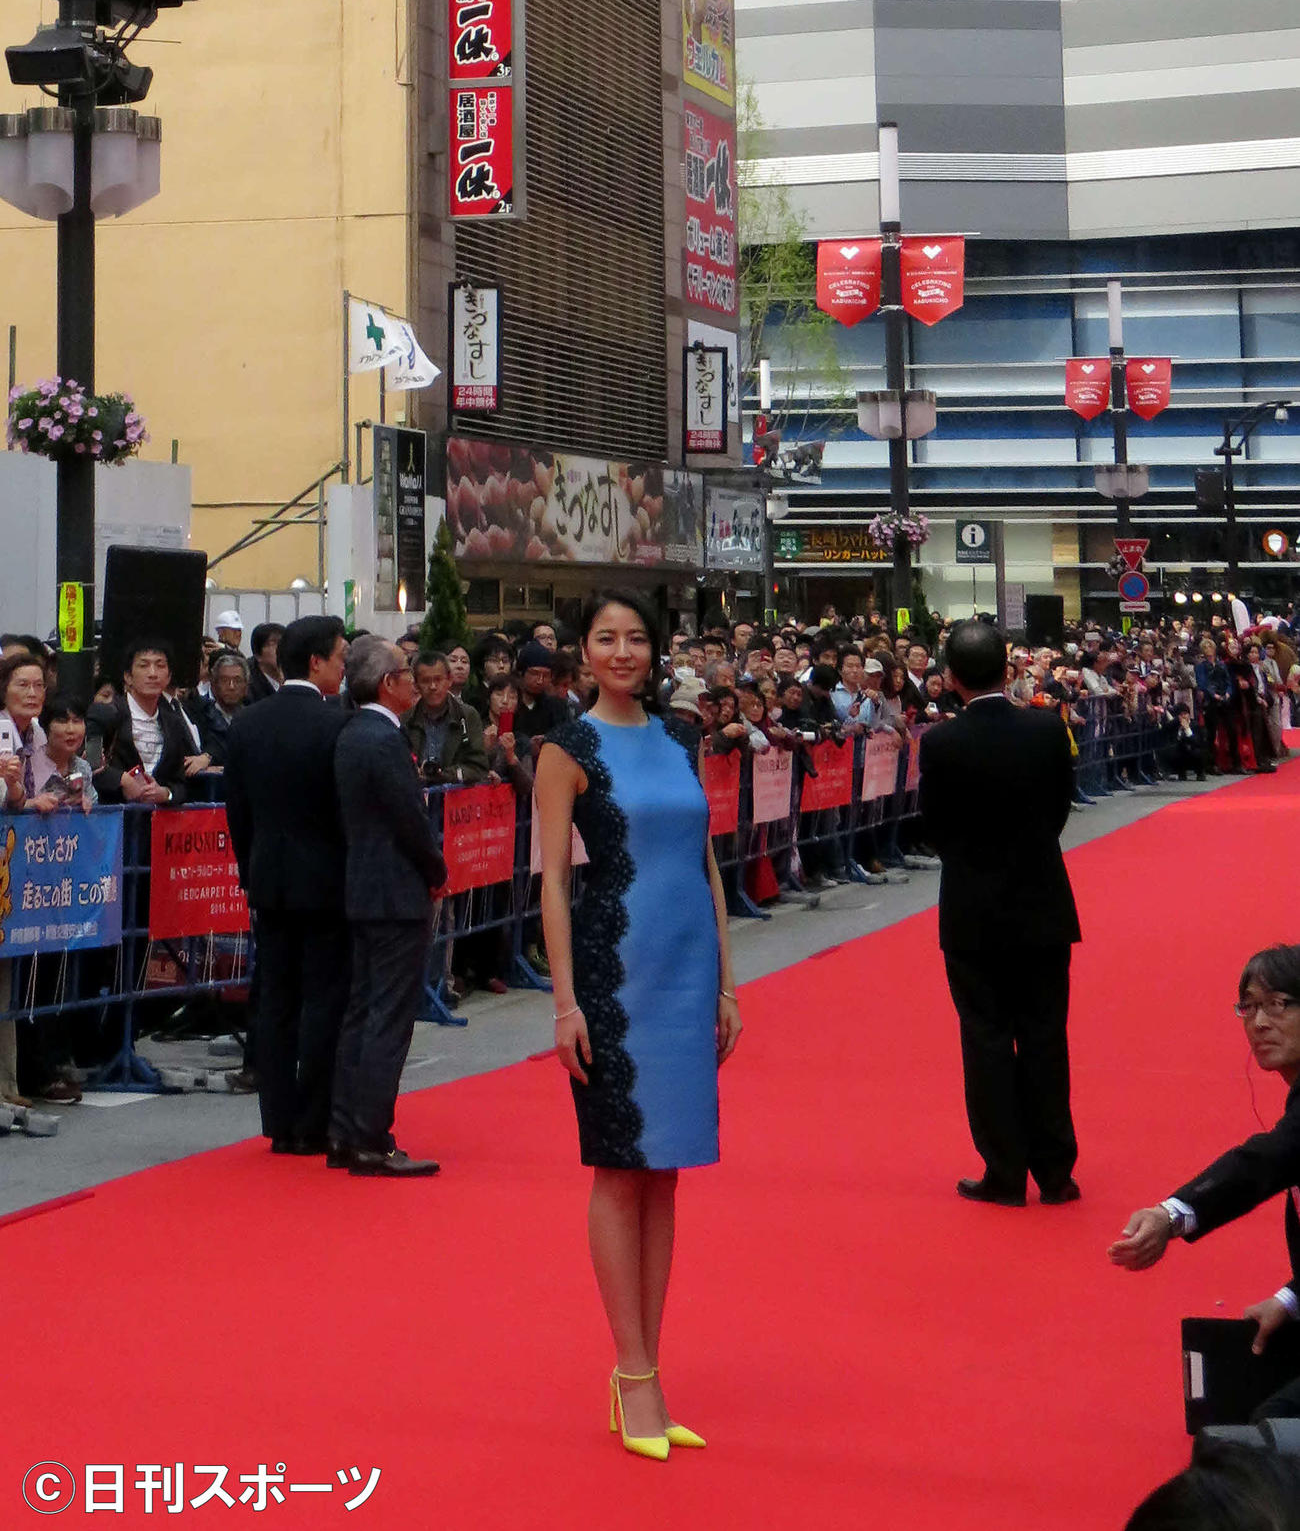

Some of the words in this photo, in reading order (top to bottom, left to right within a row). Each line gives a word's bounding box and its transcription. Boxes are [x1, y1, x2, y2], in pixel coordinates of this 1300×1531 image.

[455, 1, 494, 65] 一休
[496, 62, 512, 77] 3F
[457, 92, 477, 140] 居酒屋
[455, 138, 497, 202] 一休
[498, 199, 512, 213] 2F
[811, 530, 870, 547] 長崎ちゃん
[823, 549, 888, 560] リンガーハット
[24, 834, 79, 864] やさしさが
[22, 877, 72, 910] 走るこの街
